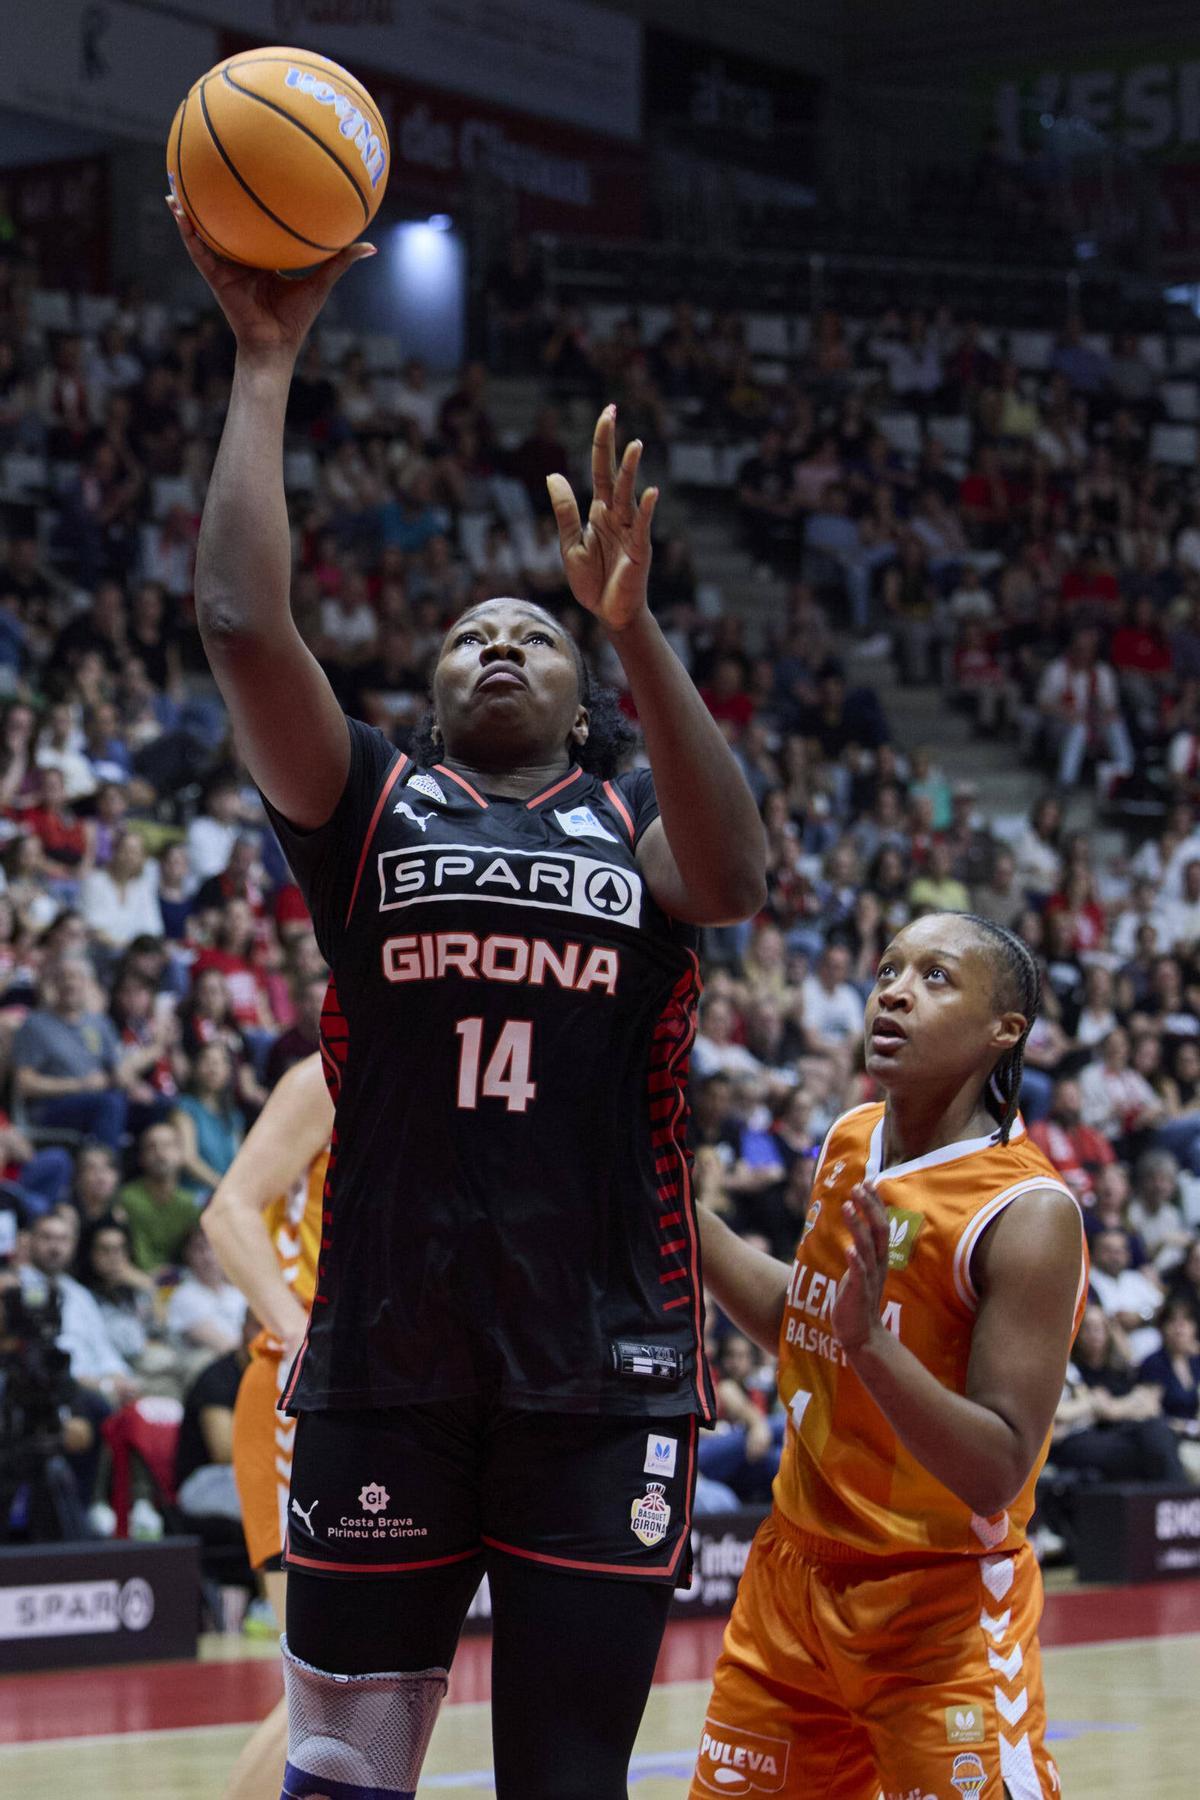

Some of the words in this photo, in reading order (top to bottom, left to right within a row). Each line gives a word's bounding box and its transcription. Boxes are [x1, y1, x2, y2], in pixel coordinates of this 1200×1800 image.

[394, 856, 572, 898] SPAR
[382, 931, 620, 996] GIRONA
[456, 1017, 537, 1113] 14
[327, 1527, 369, 1538] Pirineu
[372, 1529, 386, 1538] de
[389, 1527, 428, 1538] Girona
[340, 1516, 374, 1527] Costa
[378, 1517, 413, 1527] Brava
[632, 1517, 666, 1535] GIRONA
[637, 1508, 667, 1522] BASQUET
[16, 1591, 114, 1626] SPAR
[700, 1732, 778, 1776] PULEVA
